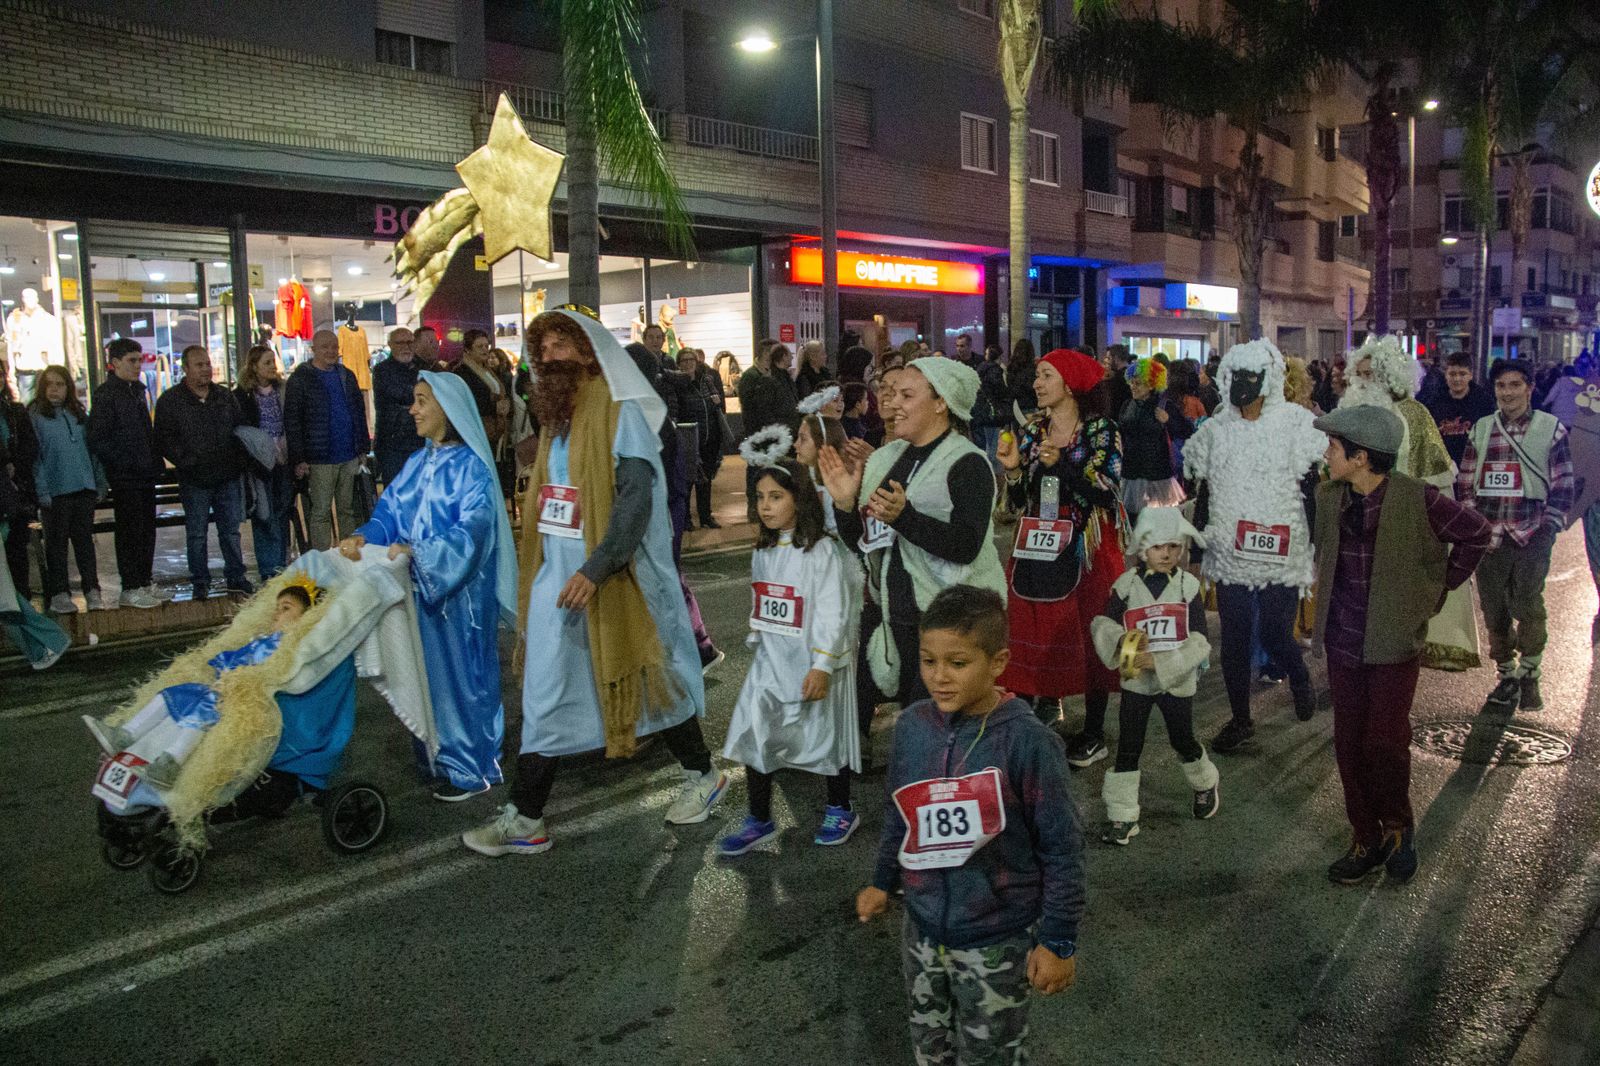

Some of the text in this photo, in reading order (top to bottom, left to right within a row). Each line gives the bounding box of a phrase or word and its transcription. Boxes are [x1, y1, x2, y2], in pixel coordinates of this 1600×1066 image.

[867, 262, 938, 286] MAPFRE
[1488, 473, 1509, 485] 159
[1032, 532, 1055, 547] 175
[1250, 534, 1275, 549] 168
[764, 600, 788, 618] 180
[1142, 619, 1169, 635] 177
[926, 806, 970, 838] 183
